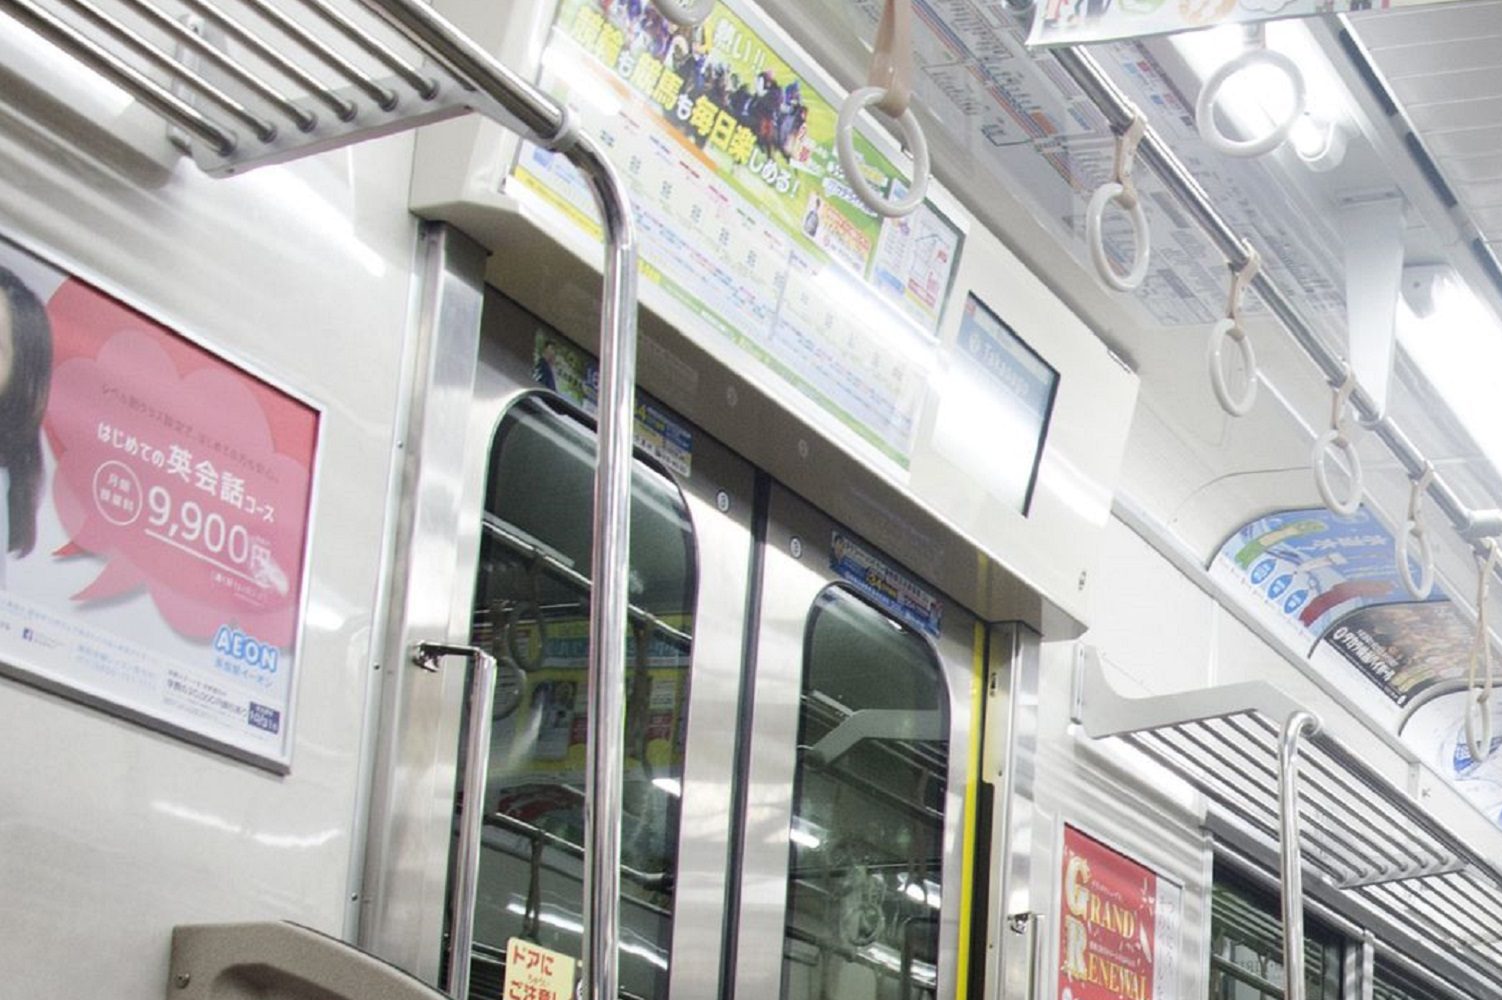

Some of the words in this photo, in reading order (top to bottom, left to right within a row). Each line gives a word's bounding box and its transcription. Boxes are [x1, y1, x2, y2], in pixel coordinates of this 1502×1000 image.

[97, 421, 275, 524] はじめての英会話コース
[216, 626, 279, 673] AEON
[1063, 855, 1136, 939] GRAND
[513, 944, 554, 977] ドアに
